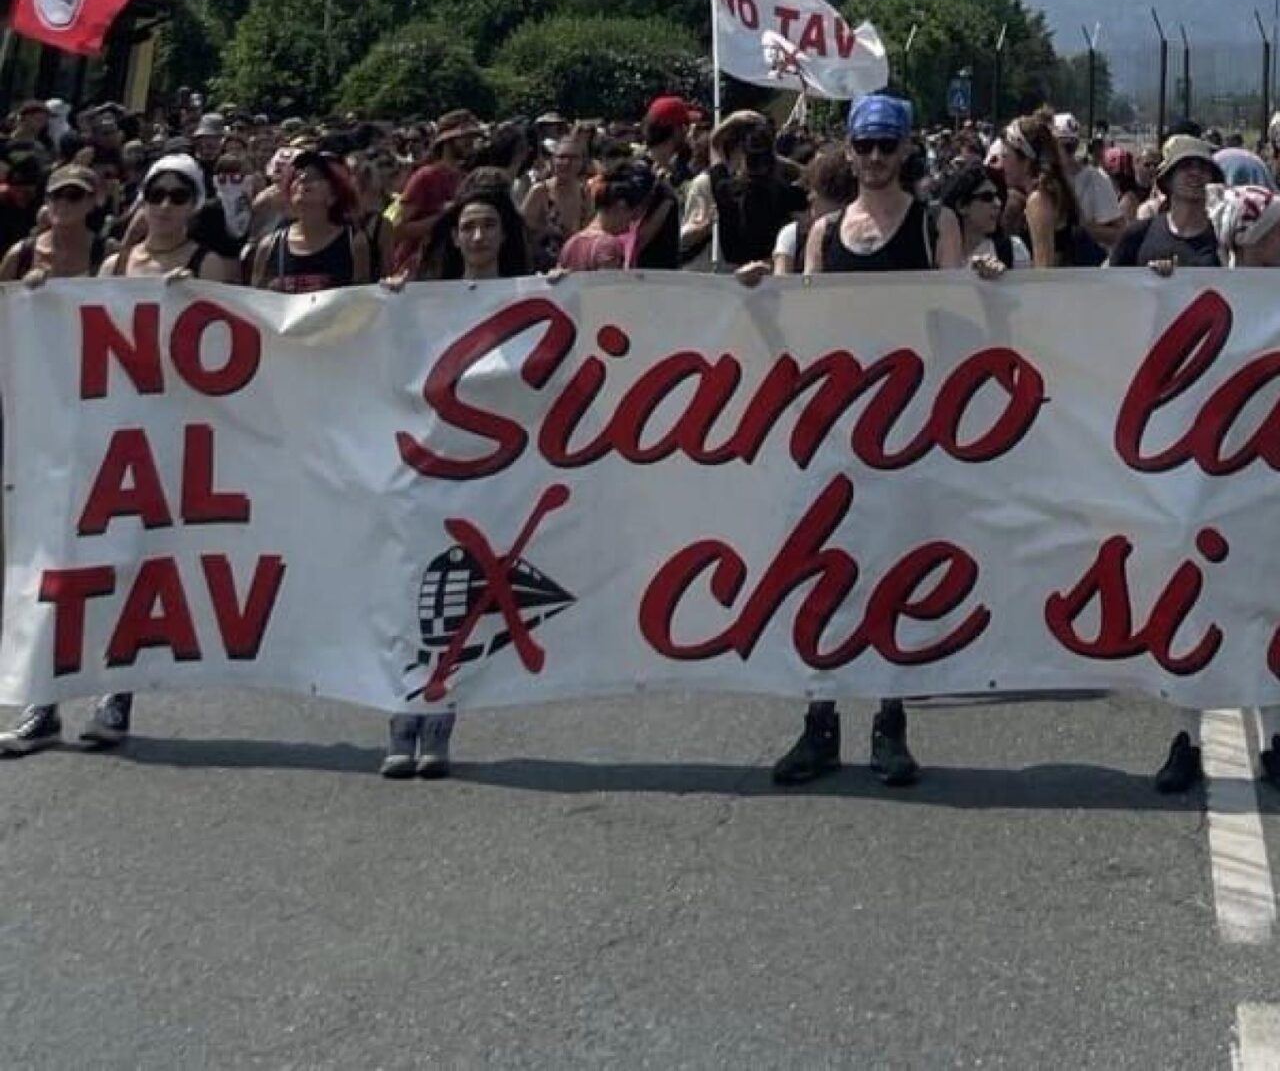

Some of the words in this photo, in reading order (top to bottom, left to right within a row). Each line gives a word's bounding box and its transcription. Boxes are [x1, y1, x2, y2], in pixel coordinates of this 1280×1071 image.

[774, 5, 856, 58] TAV
[79, 300, 262, 400] NO
[396, 296, 1050, 480] Siamo
[76, 423, 251, 536] AL
[37, 554, 287, 677] TAV
[637, 471, 992, 670] che
[1044, 525, 1224, 676] si
